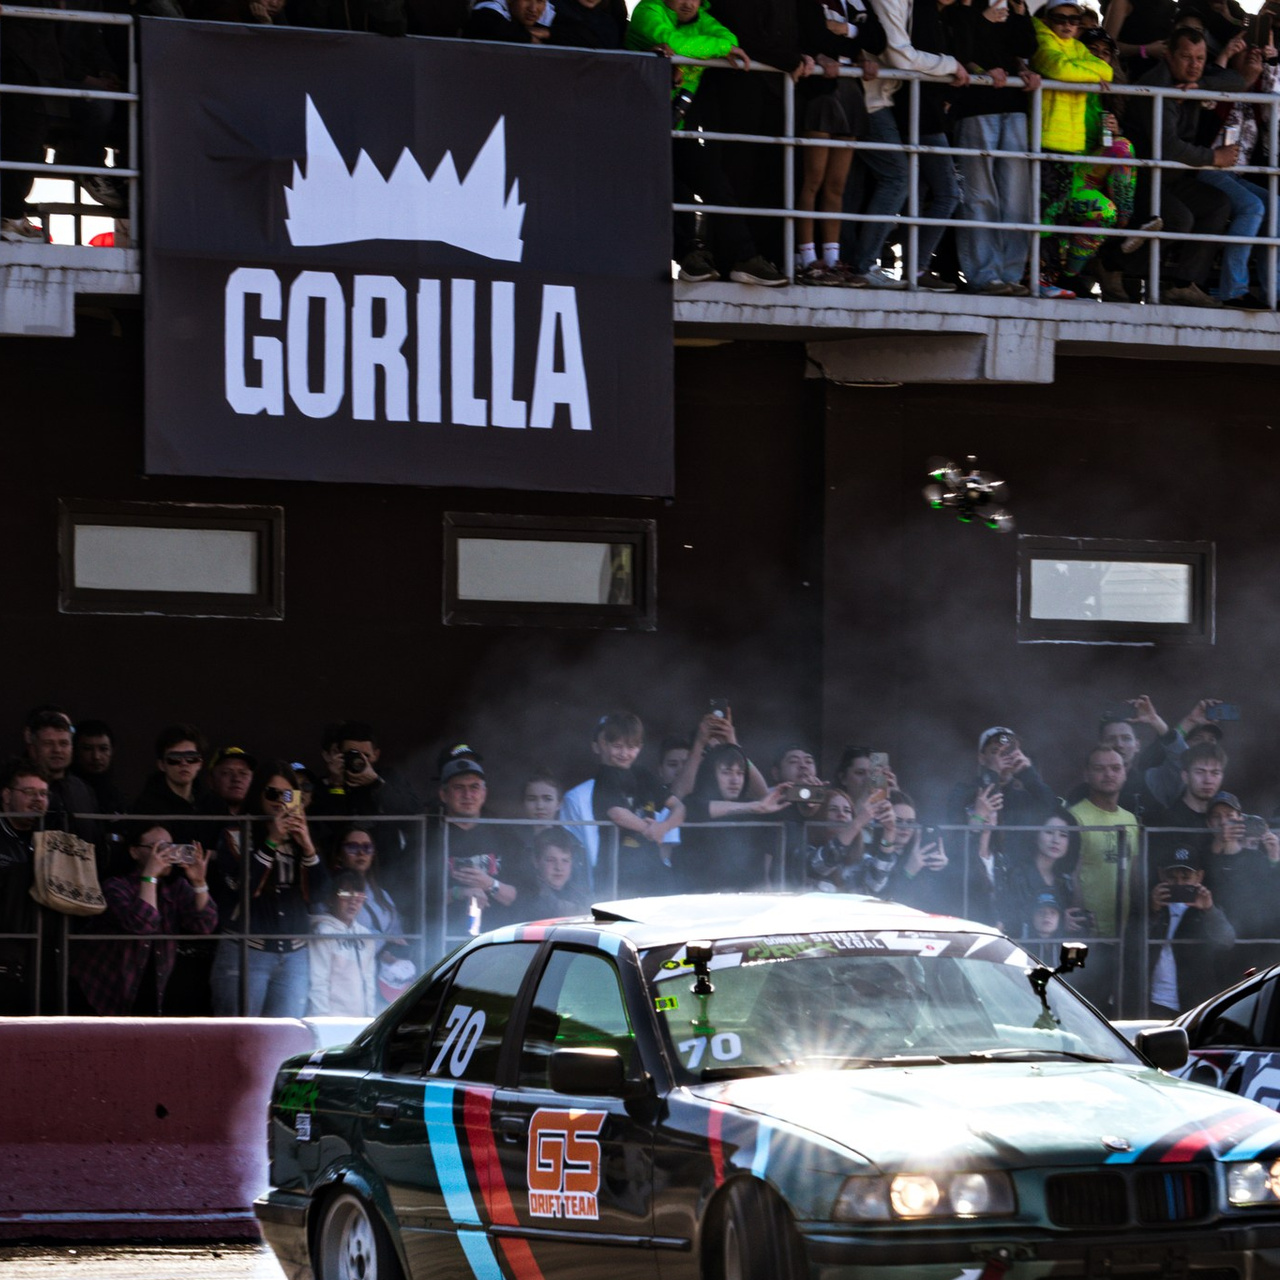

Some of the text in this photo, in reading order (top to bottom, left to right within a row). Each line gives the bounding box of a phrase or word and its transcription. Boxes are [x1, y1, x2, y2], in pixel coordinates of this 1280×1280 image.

[225, 267, 592, 430] GORILLA
[809, 932, 867, 942] STREET
[833, 938, 885, 949] LEGAL
[430, 1004, 486, 1077] 70
[678, 1032, 742, 1069] 70
[527, 1108, 608, 1194] GS
[529, 1193, 598, 1217] DRIFT TEAM
